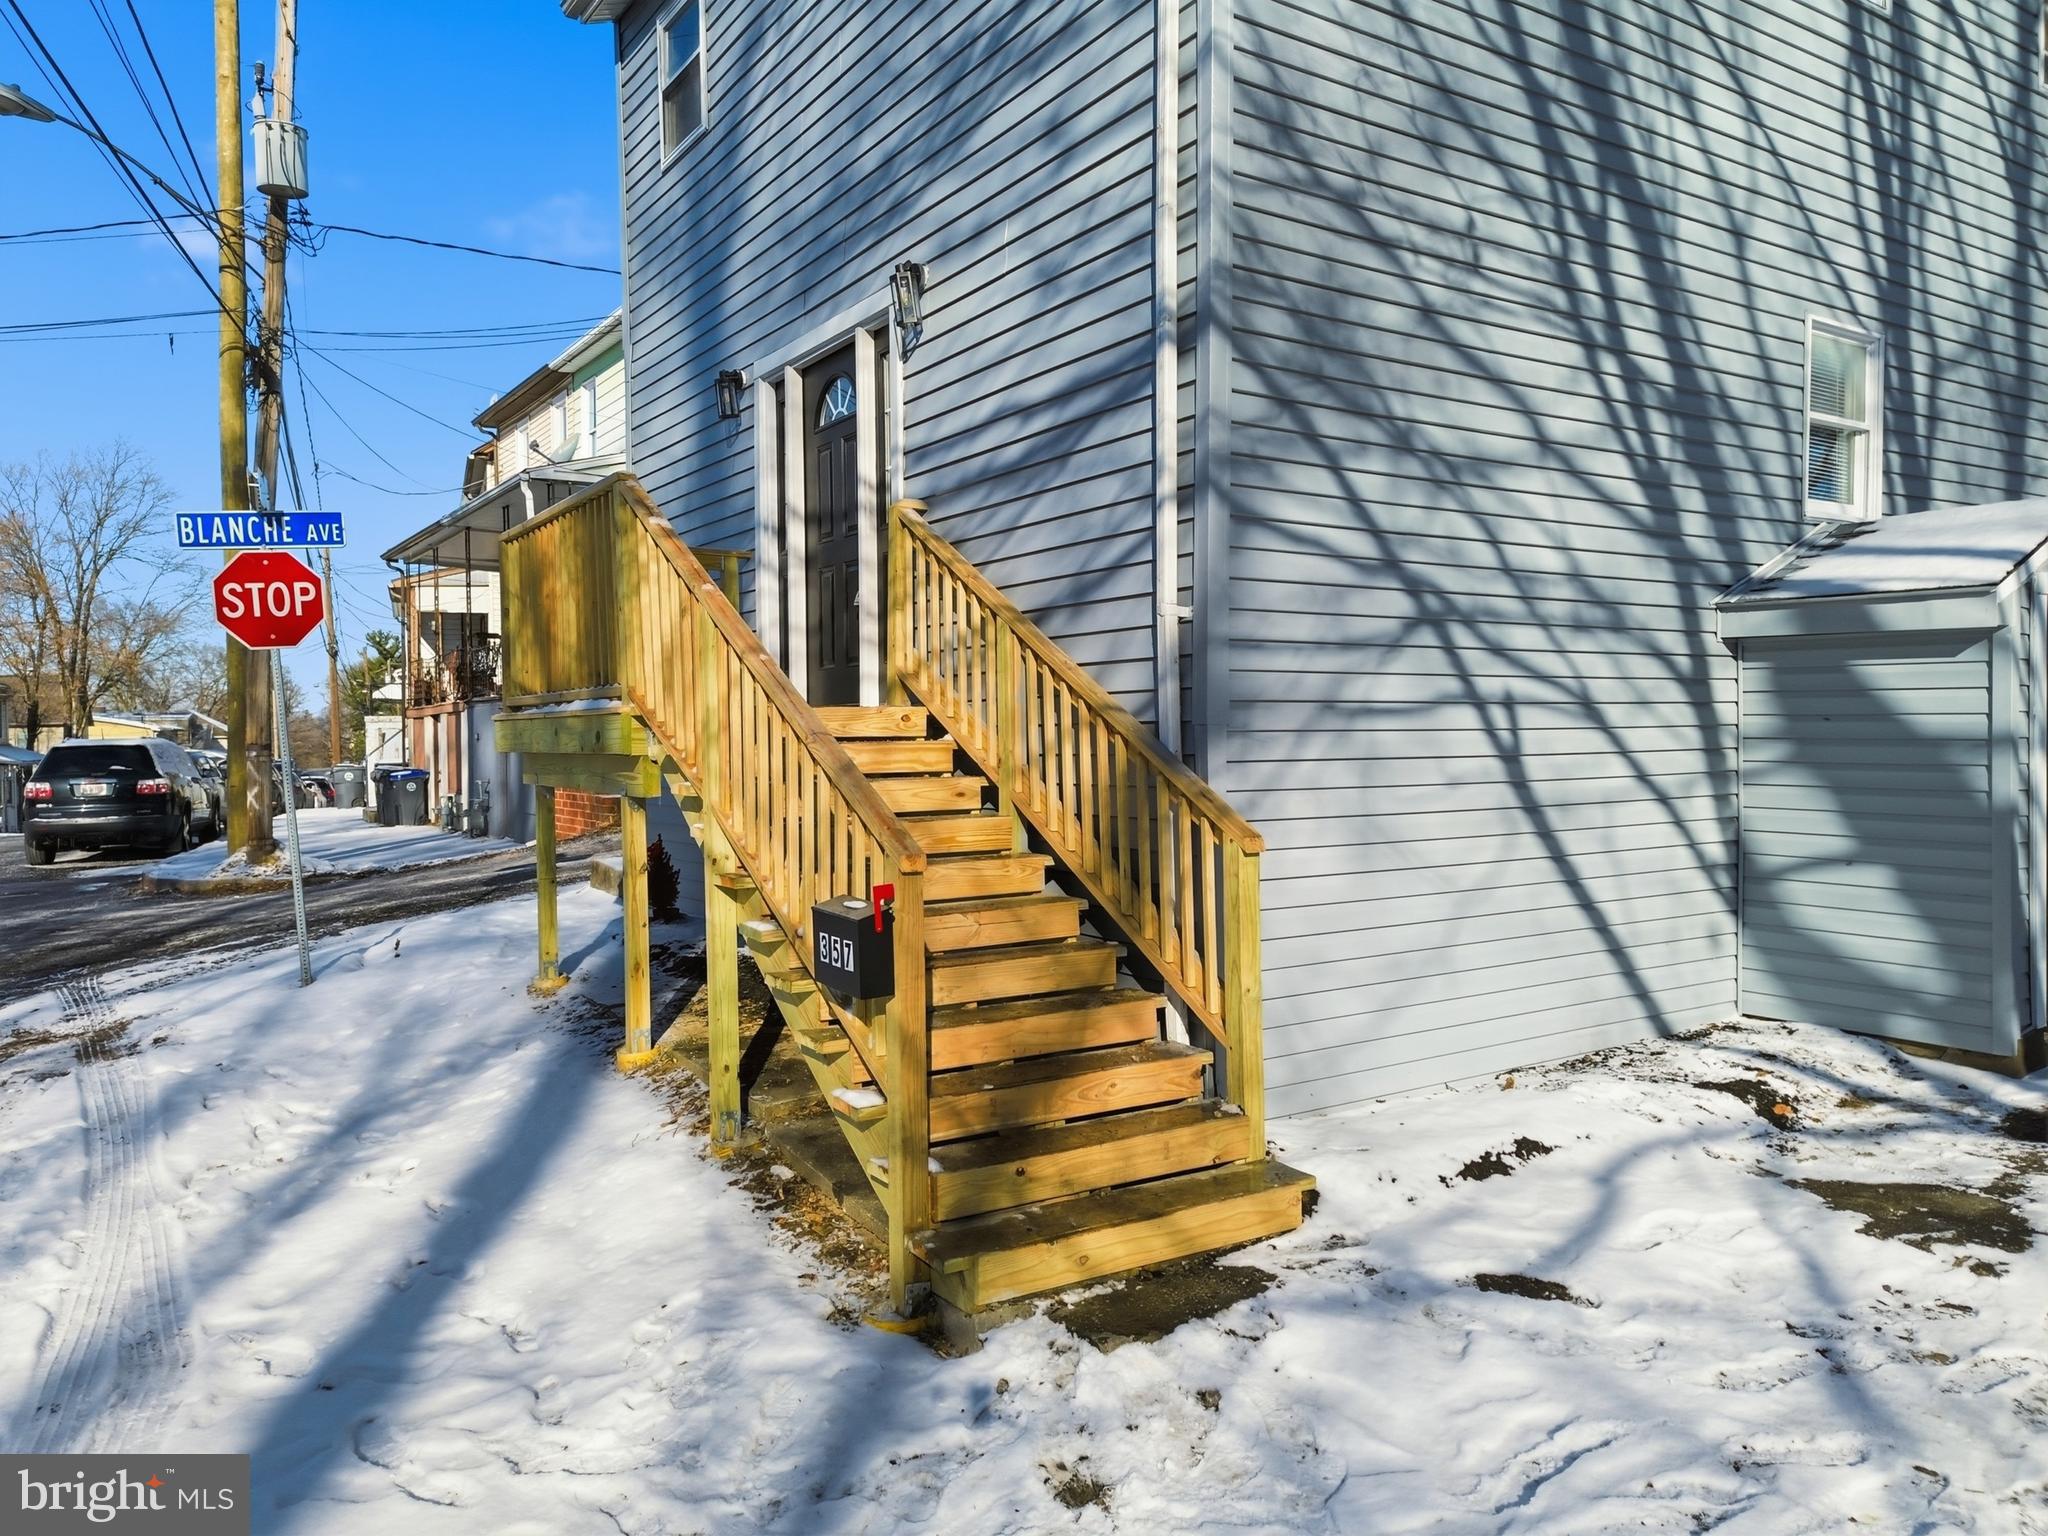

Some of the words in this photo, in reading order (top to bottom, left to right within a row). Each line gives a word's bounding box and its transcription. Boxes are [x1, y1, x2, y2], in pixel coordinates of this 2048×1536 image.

[179, 516, 294, 544] BLANCHE
[306, 523, 342, 542] AVE
[222, 581, 317, 619] STOP
[820, 933, 854, 971] 357
